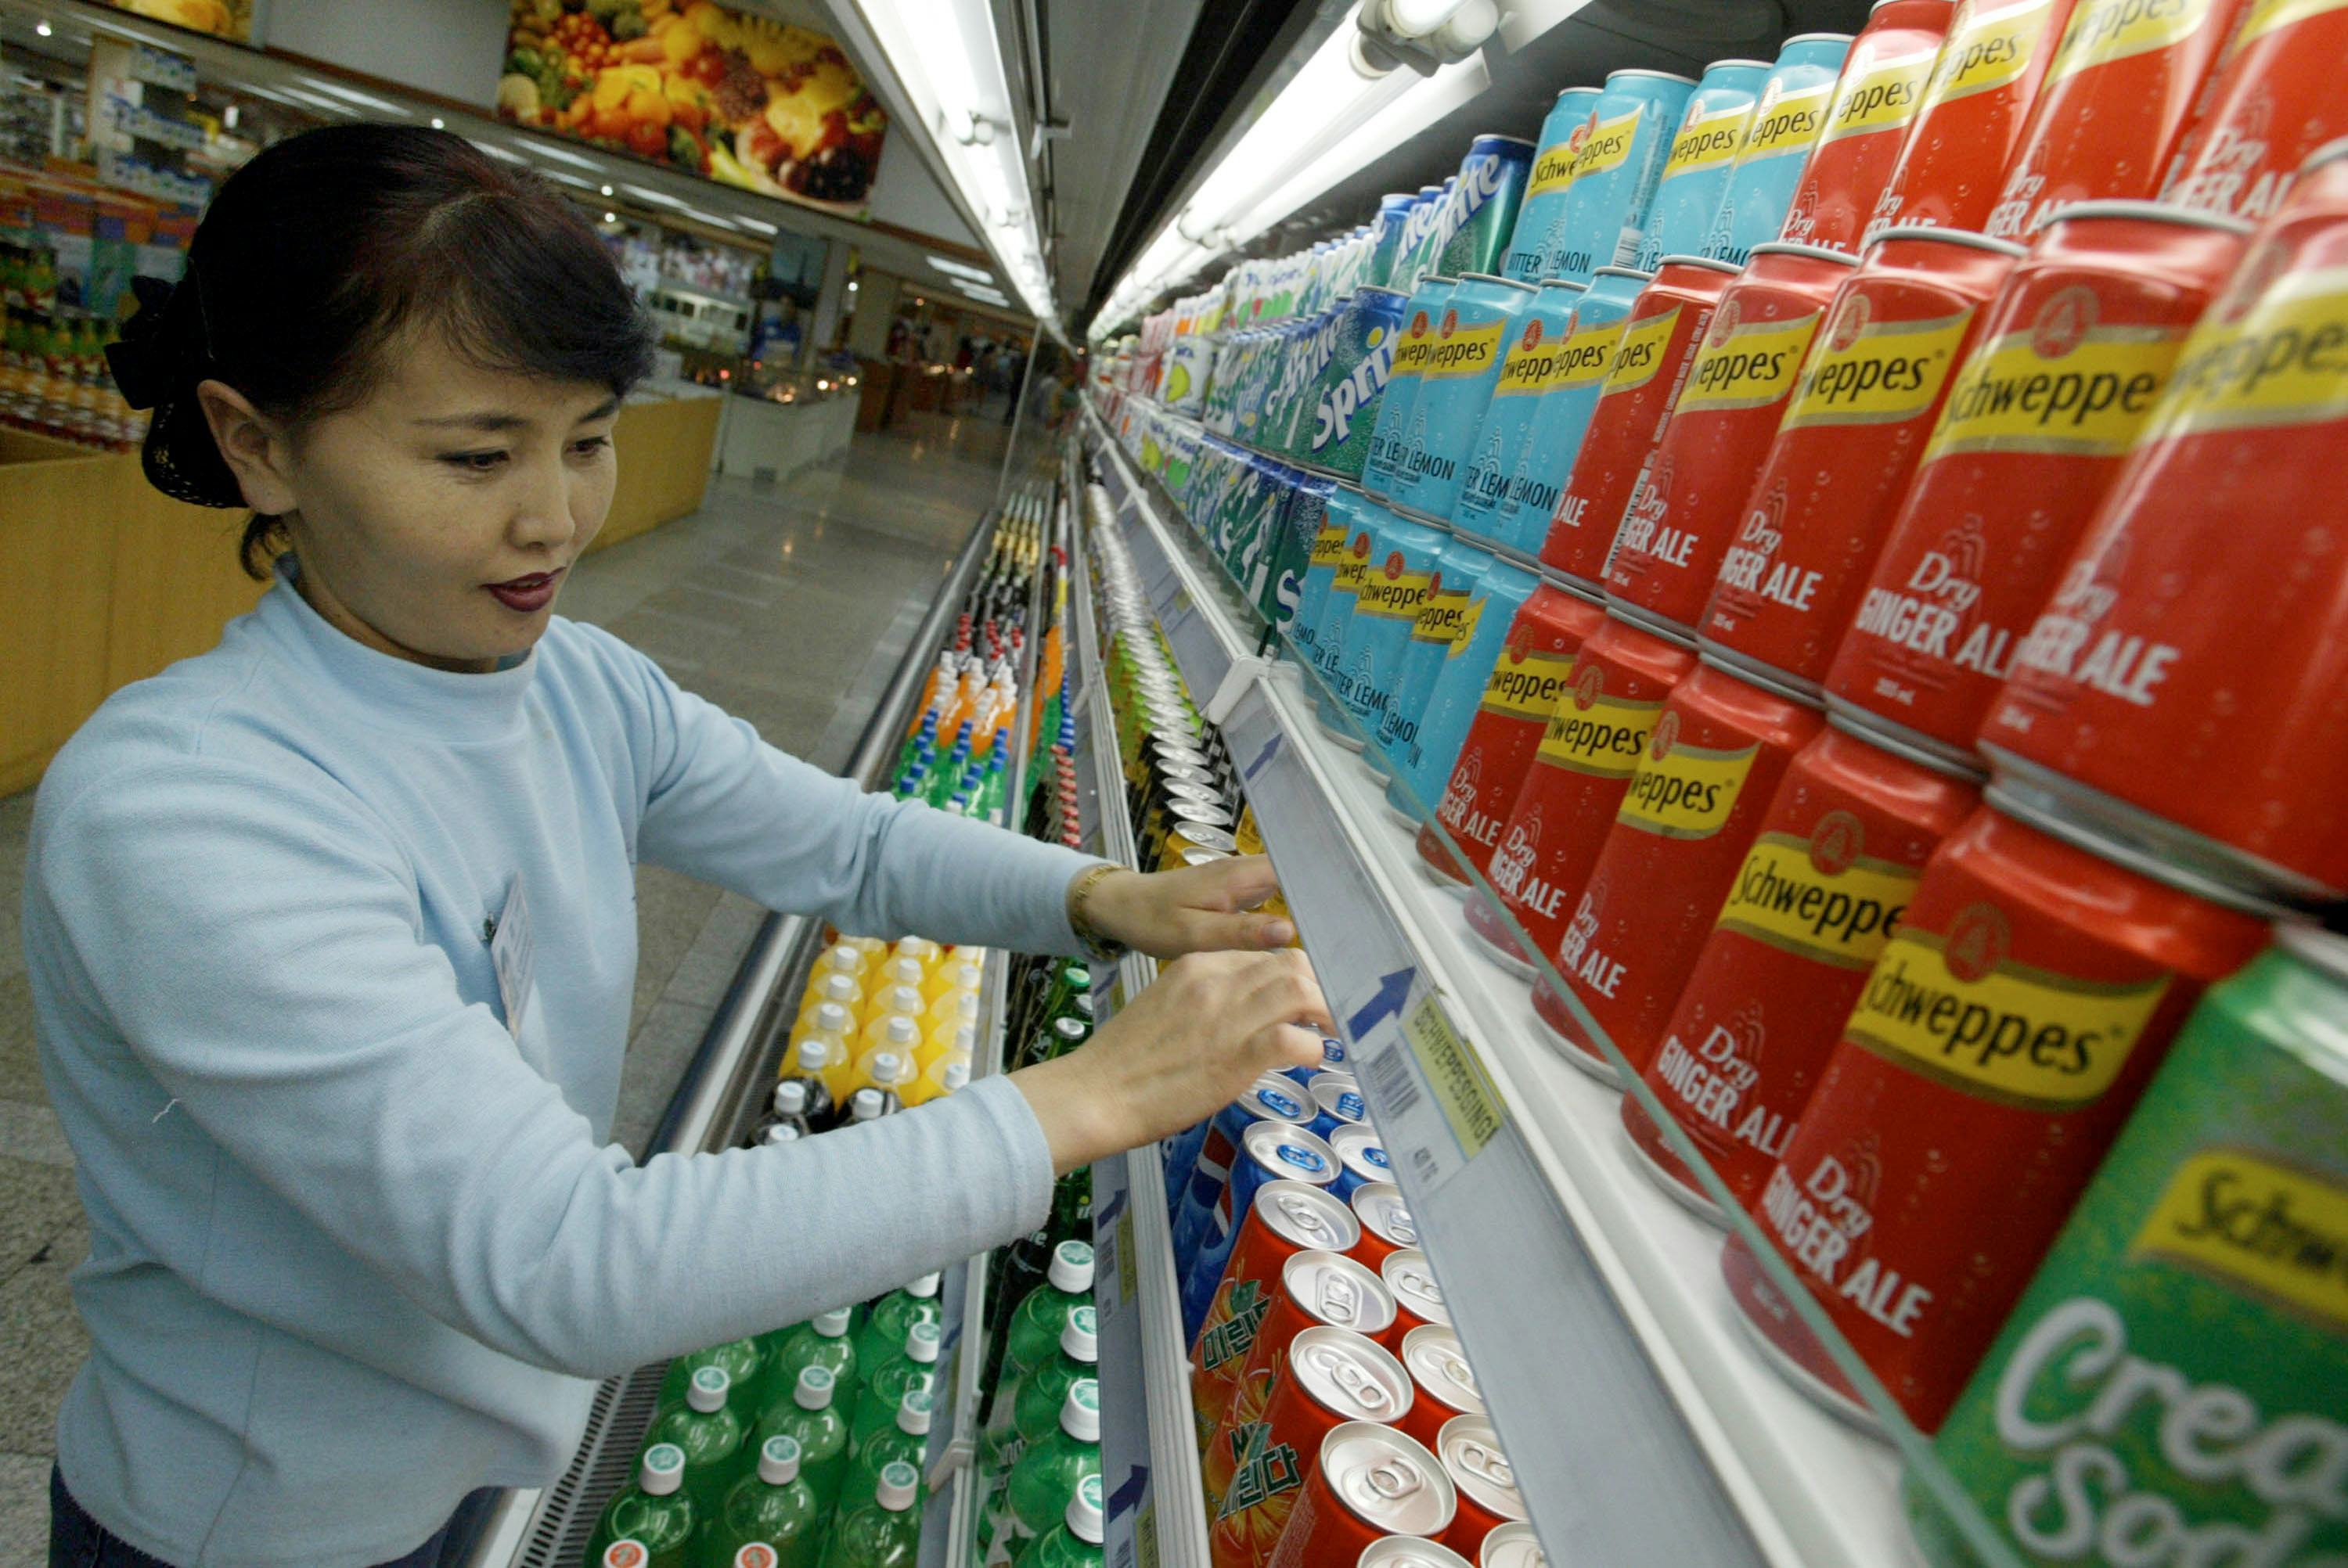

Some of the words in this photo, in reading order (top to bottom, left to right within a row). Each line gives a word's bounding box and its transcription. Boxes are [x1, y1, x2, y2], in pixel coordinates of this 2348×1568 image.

[1873, 187, 1905, 217] Dry
[2003, 164, 2046, 198] Dry
[1786, 209, 1816, 236] Dry
[1549, 250, 1592, 274] LEMON
[1407, 448, 1457, 481] LEMON
[1509, 475, 1559, 512] LEMON
[1637, 484, 1669, 521] Dry
[1651, 525, 1699, 570] ALE
[1741, 509, 1784, 555] Dry
[1761, 562, 1824, 613] ALE
[1907, 551, 1982, 614] Dry
[2058, 560, 2121, 623] Dry
[2075, 630, 2181, 707] ALE
[1453, 766, 1478, 804] Dry
[1462, 813, 1504, 848] ALE
[1506, 824, 1537, 869] Dry
[1519, 880, 1567, 921] ALE
[1575, 891, 1602, 938] Dry
[1579, 951, 1629, 1000] ALE
[1698, 1025, 1760, 1093] Dry
[1655, 1034, 1740, 1131] GINGER
[1806, 1155, 1875, 1239] Dry
[1841, 1257, 1935, 1340] ALE
